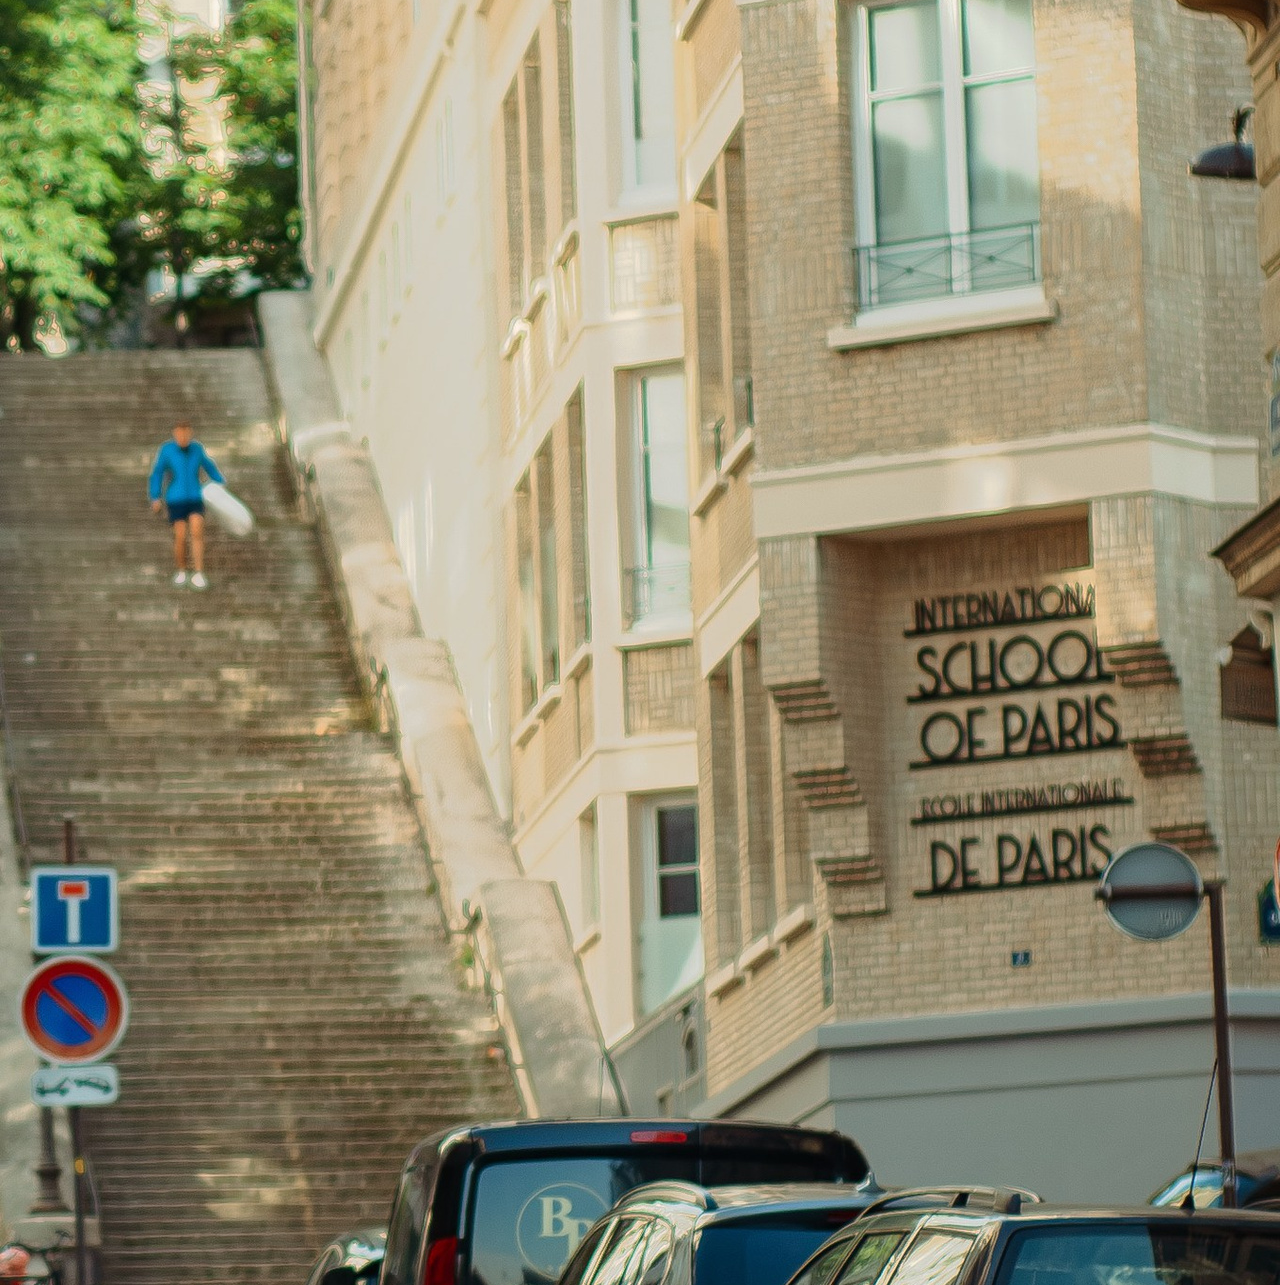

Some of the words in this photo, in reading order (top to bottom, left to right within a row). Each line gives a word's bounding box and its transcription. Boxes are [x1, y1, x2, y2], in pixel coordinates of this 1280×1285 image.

[917, 629, 1115, 697] SCHOOL
[921, 706, 988, 763] OF
[1002, 693, 1122, 757] PARIS
[980, 778, 1125, 815] INTERNATIONALE
[931, 837, 981, 891] DE
[997, 823, 1111, 886] PARIS
